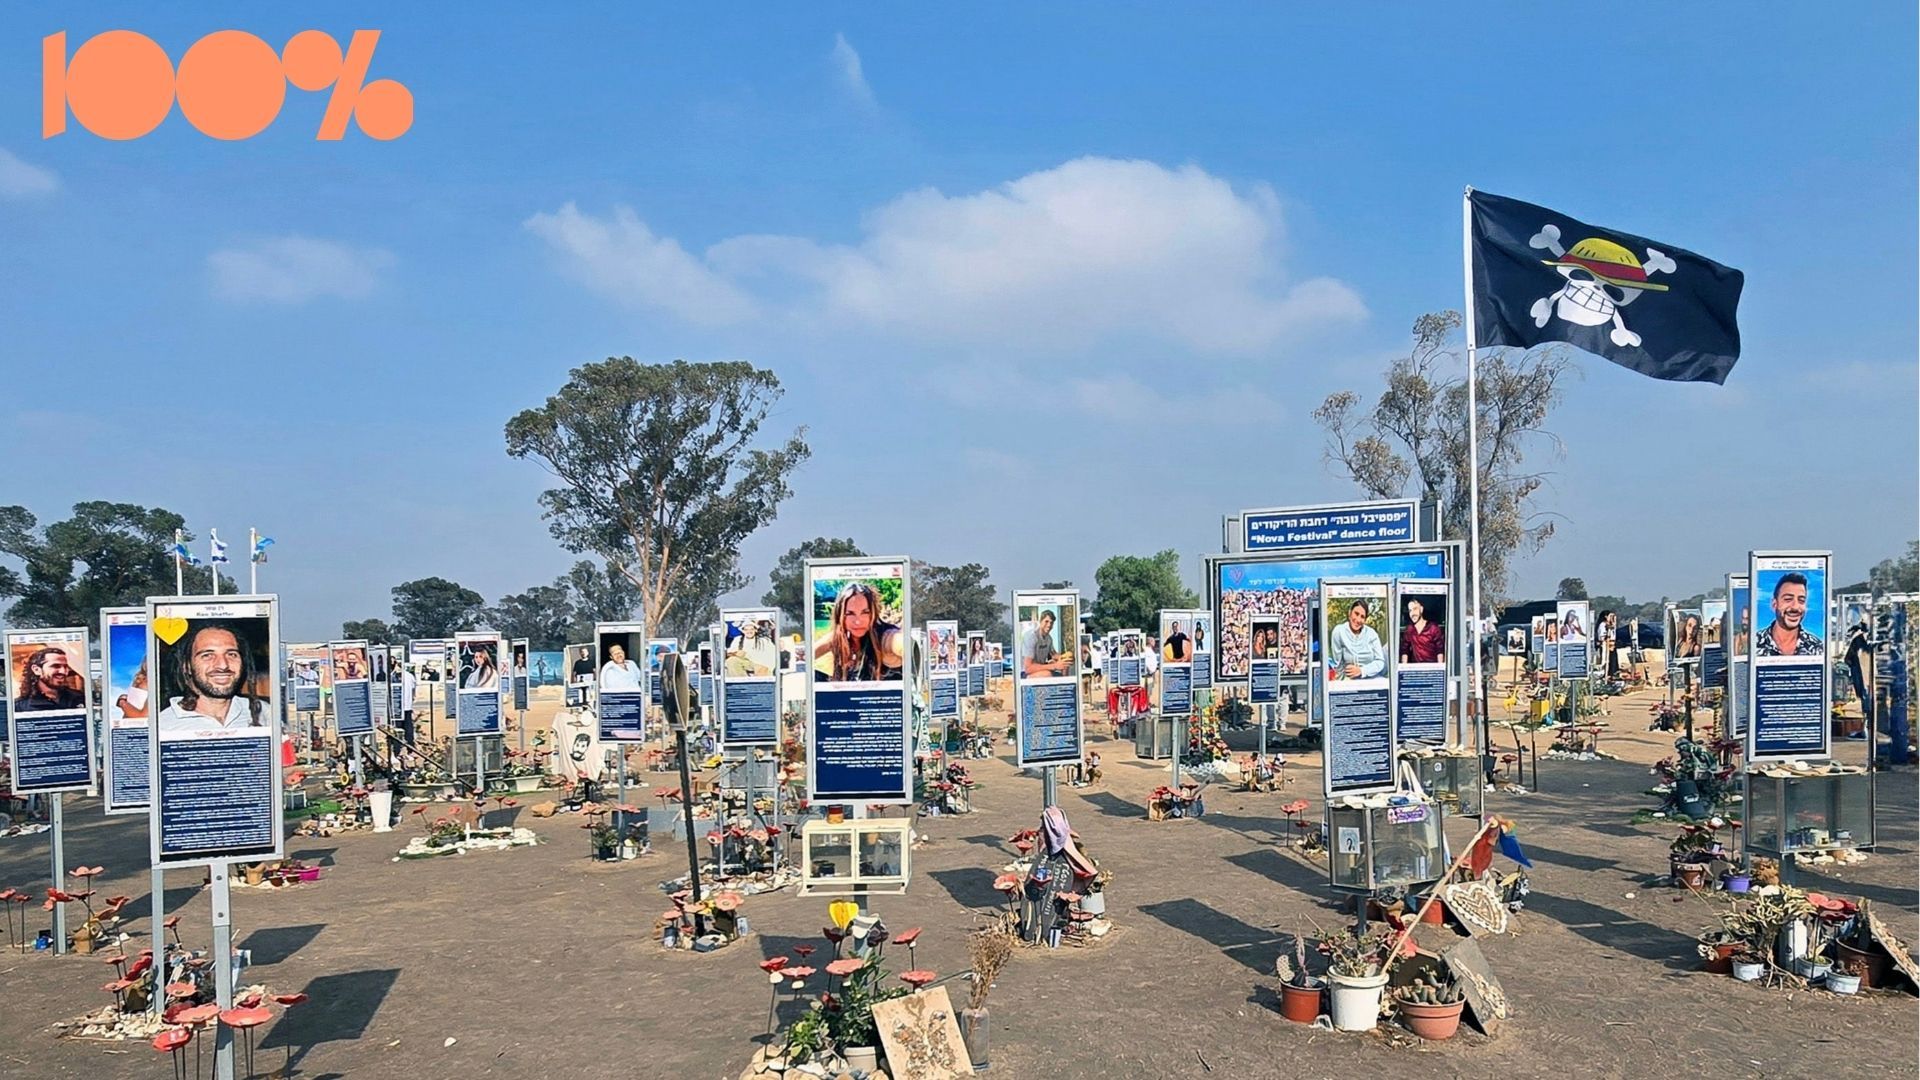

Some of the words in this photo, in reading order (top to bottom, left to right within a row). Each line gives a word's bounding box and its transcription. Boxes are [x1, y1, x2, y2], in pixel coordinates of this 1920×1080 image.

[1251, 520, 1297, 530] הריקודים
[1300, 518, 1328, 527] רחבת
[1340, 529, 1375, 538] dance
[1378, 527, 1407, 536] floor
